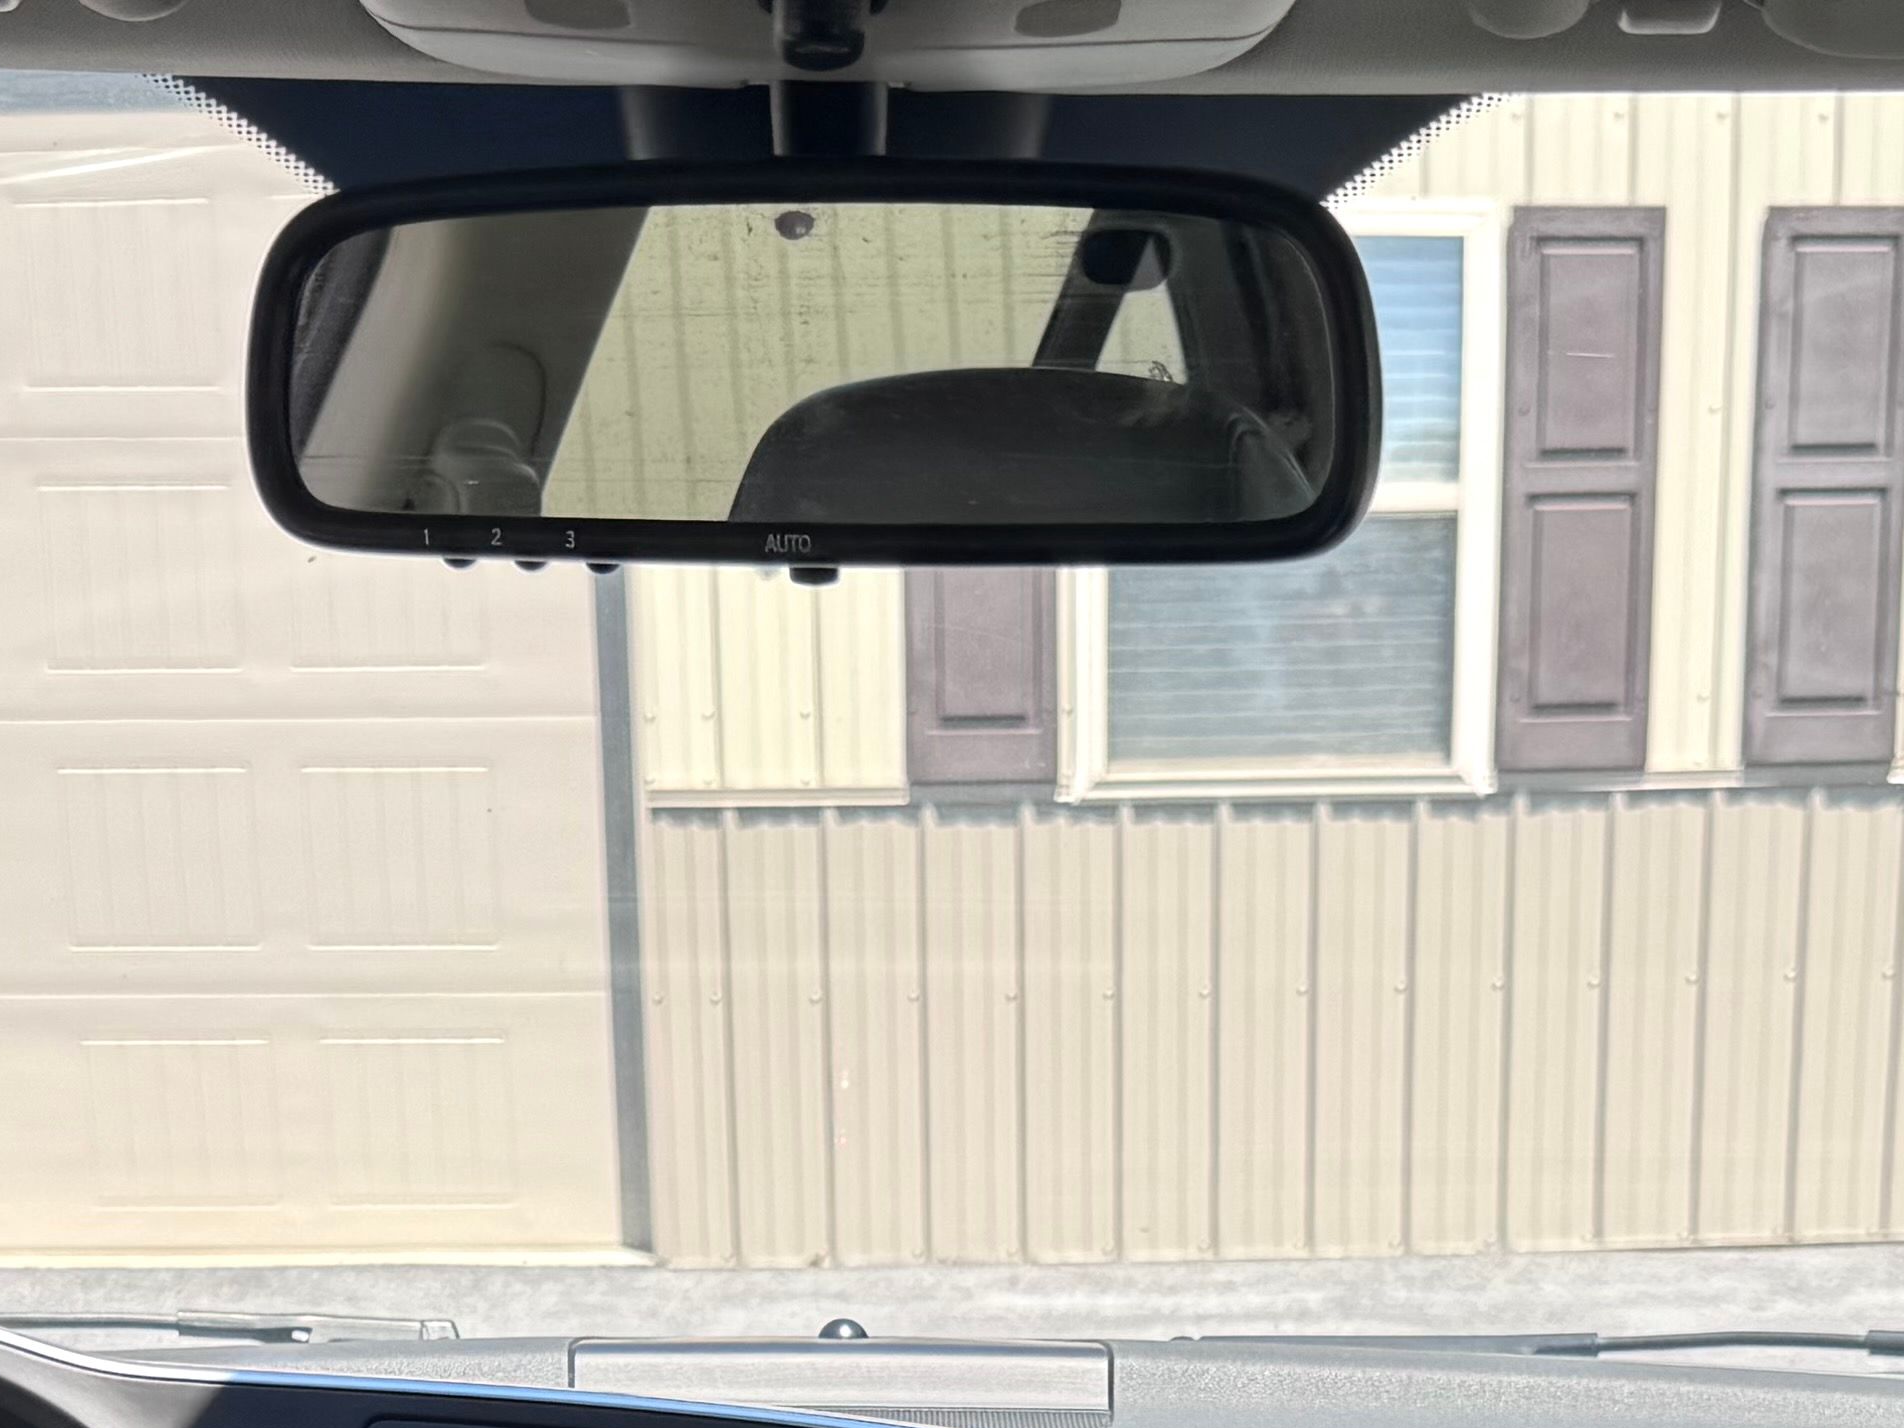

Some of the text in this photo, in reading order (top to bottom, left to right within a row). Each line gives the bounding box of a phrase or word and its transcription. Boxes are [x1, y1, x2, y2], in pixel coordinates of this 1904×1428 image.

[422, 528, 430, 546] 1
[491, 528, 502, 547] 2
[565, 530, 576, 549] 3
[765, 533, 813, 554] AUTO
